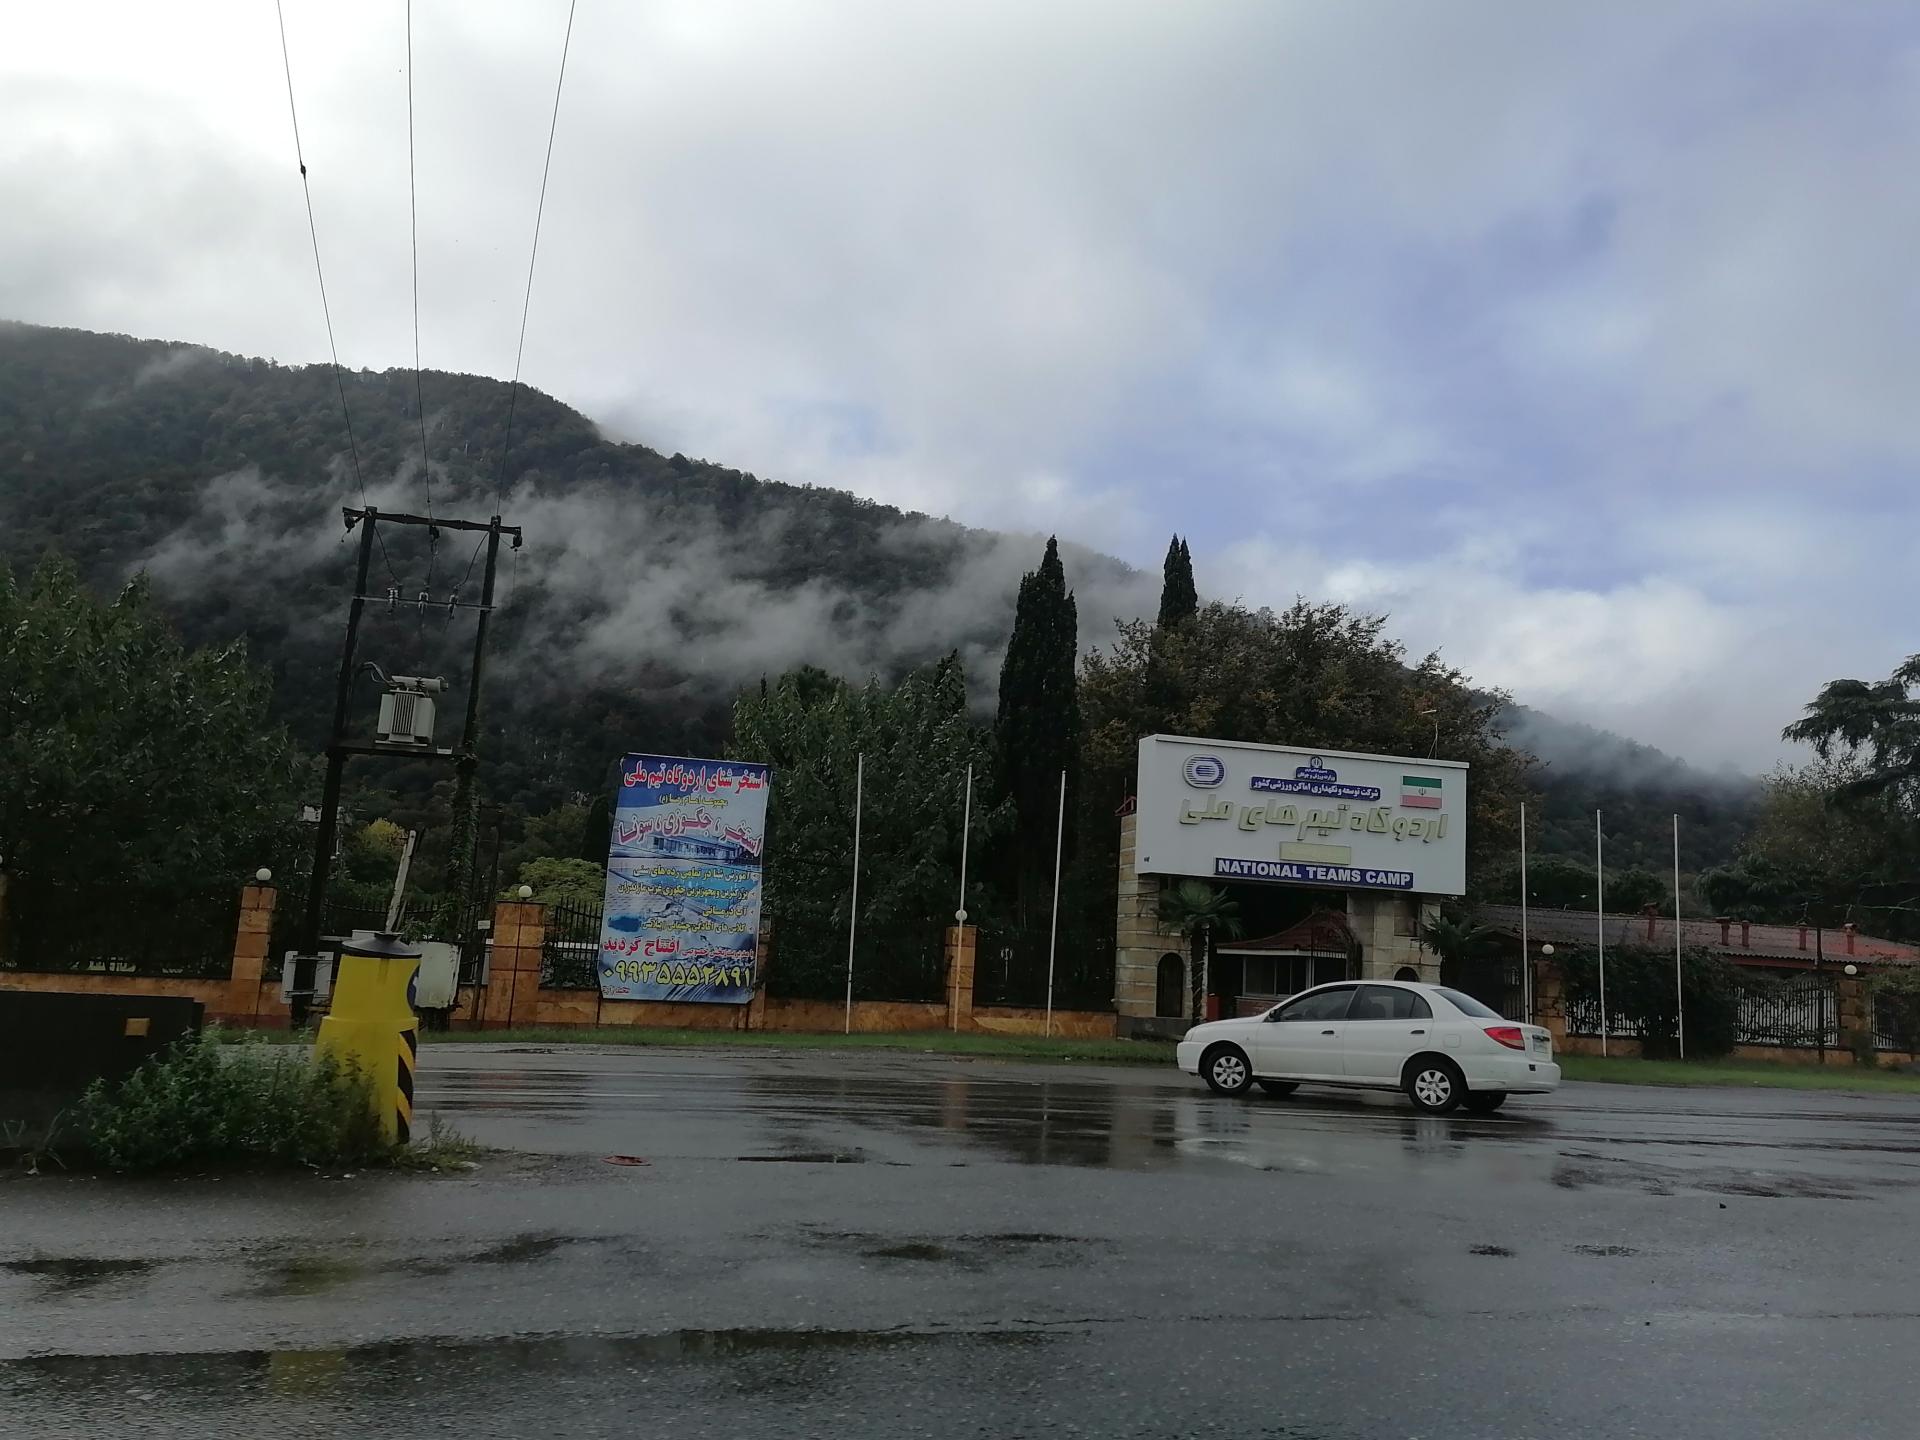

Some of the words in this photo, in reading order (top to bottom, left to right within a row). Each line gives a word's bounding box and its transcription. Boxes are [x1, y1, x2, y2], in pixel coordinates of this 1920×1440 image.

[624, 760, 647, 787] ملی
[647, 762, 666, 789] تیم
[666, 763, 706, 793] اردوگاه
[705, 766, 732, 793] شنای
[735, 769, 768, 794] استخر
[1254, 778, 1270, 789] کشور
[1270, 780, 1292, 791] ورزشی
[1292, 782, 1311, 792] اماکن
[1311, 783, 1338, 794] نگهداری
[1342, 786, 1360, 797] توسعه
[1361, 787, 1379, 798] شرکت
[1179, 794, 1234, 825] ملی
[1239, 799, 1298, 832] های
[1297, 804, 1351, 841] تیم
[618, 812, 653, 846] سونا
[1351, 806, 1448, 843] اردوگاه
[1218, 859, 1301, 878] NATIONAL
[1305, 866, 1361, 883] TEAMS
[1365, 871, 1411, 886] CAMP
[644, 938, 680, 956] افتتاح
